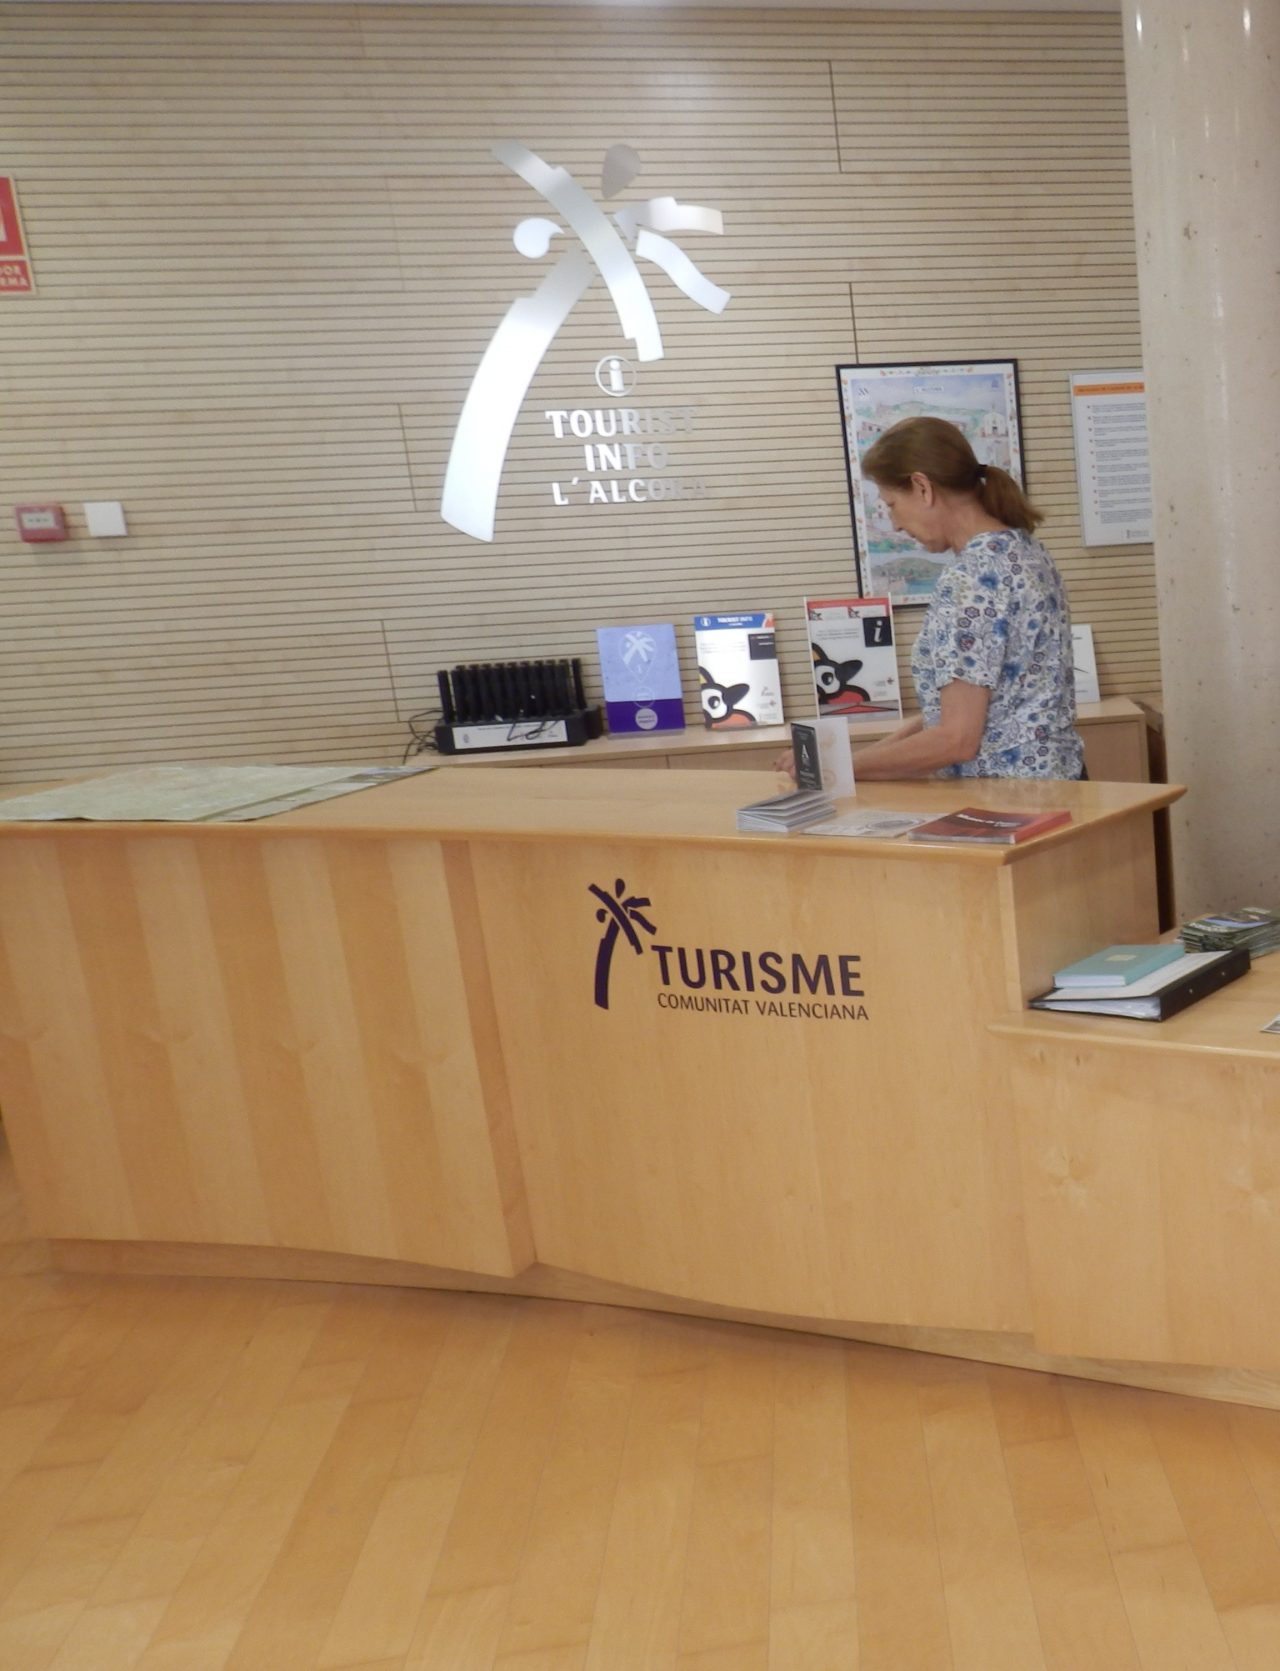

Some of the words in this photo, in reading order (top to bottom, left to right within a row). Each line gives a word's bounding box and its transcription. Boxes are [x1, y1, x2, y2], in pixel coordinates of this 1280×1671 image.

[545, 408, 697, 439] TOURIST
[584, 442, 668, 472] INFO
[651, 945, 865, 997] TURISME
[657, 992, 750, 1015] COMUNITAT
[755, 1000, 869, 1020] VALENCIANA
